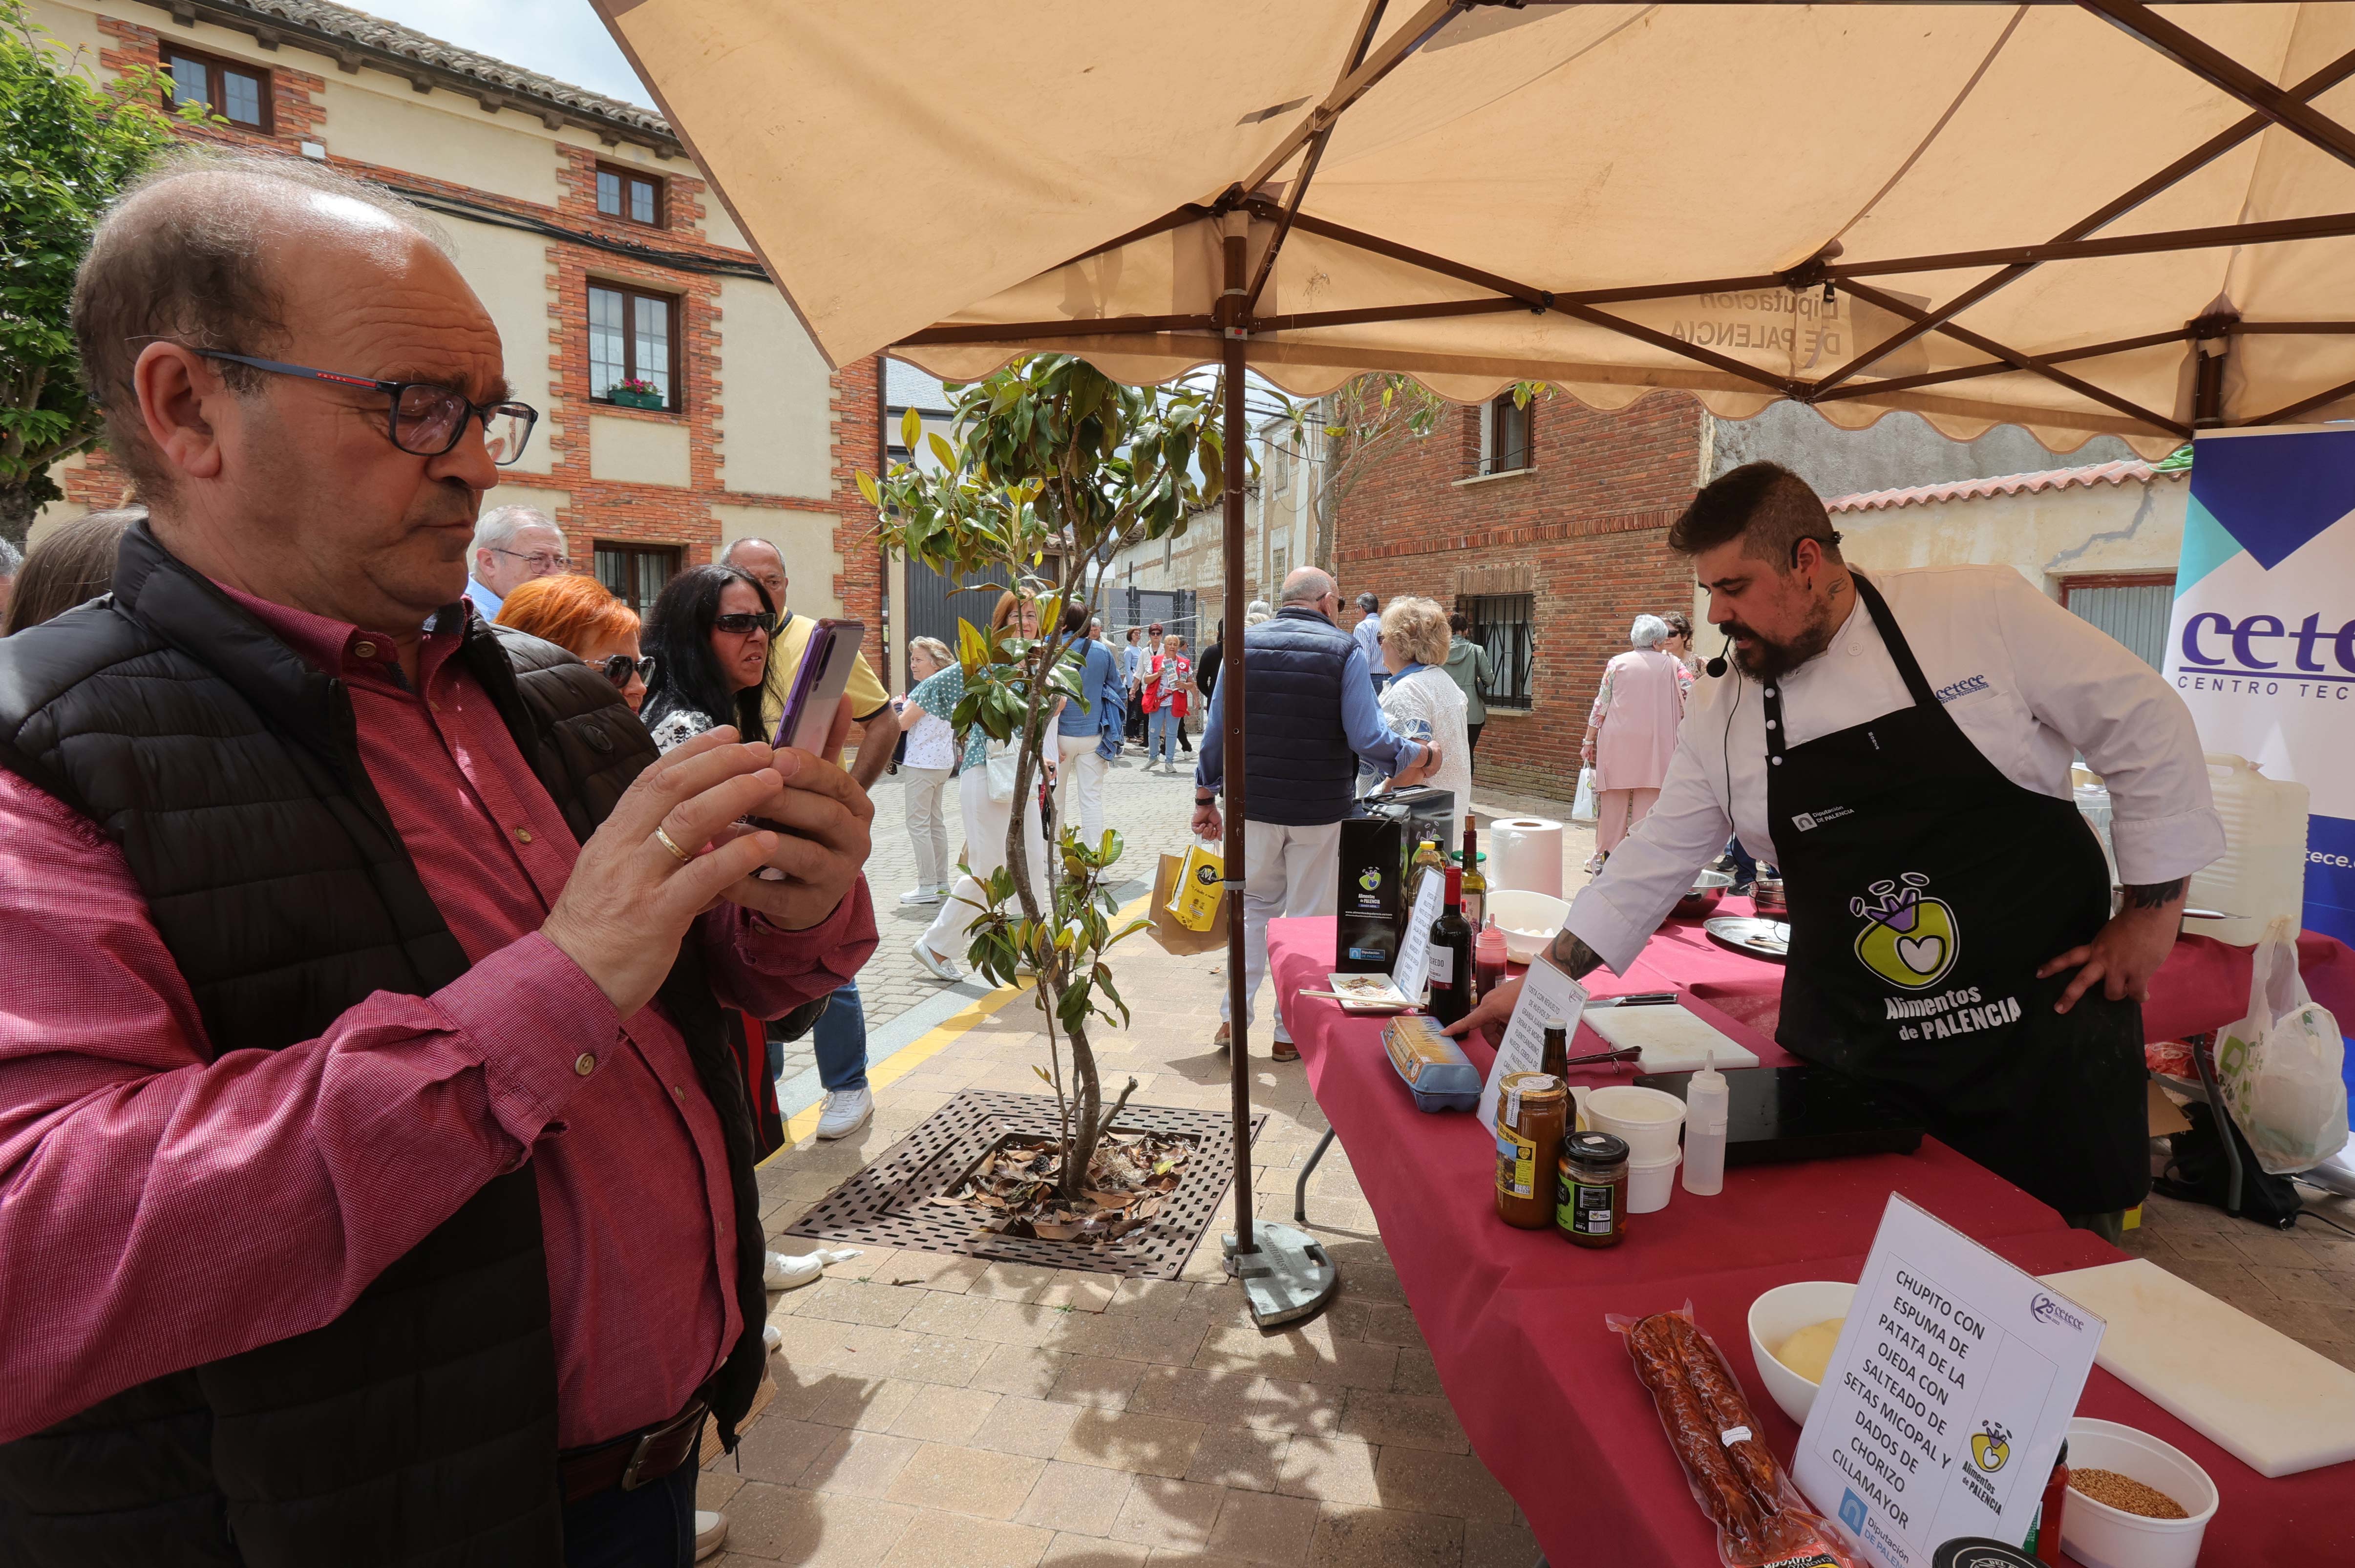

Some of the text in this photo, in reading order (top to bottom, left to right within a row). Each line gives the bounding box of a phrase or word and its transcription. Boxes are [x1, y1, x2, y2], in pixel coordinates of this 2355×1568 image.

[318, 373, 346, 381] PRADA
[1936, 675, 1987, 699] cetece
[2178, 676, 2349, 700] CENTRO TEC
[1812, 805, 1844, 817] Diputación
[1825, 808, 1855, 821] PALENCIA
[1429, 956, 1444, 967] EGREDO
[1528, 984, 1537, 997] TOSTA
[1544, 997, 1560, 1015] REVUELTO
[1528, 999, 1534, 1008] DE
[1533, 1002, 1546, 1017] HUEVOS
[1884, 986, 1981, 1020] Alimentos
[1516, 1017, 1545, 1046] CREMA DE MORCILL
[1522, 1008, 1544, 1031] GRANJA JUANIT
[1898, 996, 2022, 1040] de PALENCIA
[1503, 1060, 1517, 1073] CARAM
[1510, 1053, 1528, 1072] PALENZUELA
[1520, 1048, 1533, 1065] CEBOLLA
[1532, 1060, 1539, 1069] DE
[1896, 1270, 1986, 1340] CHUPITO CON
[2034, 1297, 2056, 1315] 25
[2055, 1307, 2084, 1331] cetece
[1893, 1296, 1969, 1359] ESPUMA DE
[1878, 1313, 1966, 1390] PATATA DE LA
[1878, 1342, 1949, 1406] OJEDA CON
[1863, 1359, 1947, 1436] SALTEADO DE
[1844, 1372, 1952, 1470] SETAS MICOPAL Y
[1855, 1410, 1919, 1475] DADOS DE
[1851, 1437, 1906, 1493] CHORIZO
[1961, 1460, 1996, 1495] Alimentos
[1832, 1449, 1909, 1530] CILLAMAYOR
[1962, 1476, 2002, 1516] de PALENCIA
[1865, 1529, 1907, 1568] DE PALEN
[1867, 1516, 1909, 1564] Diputación
